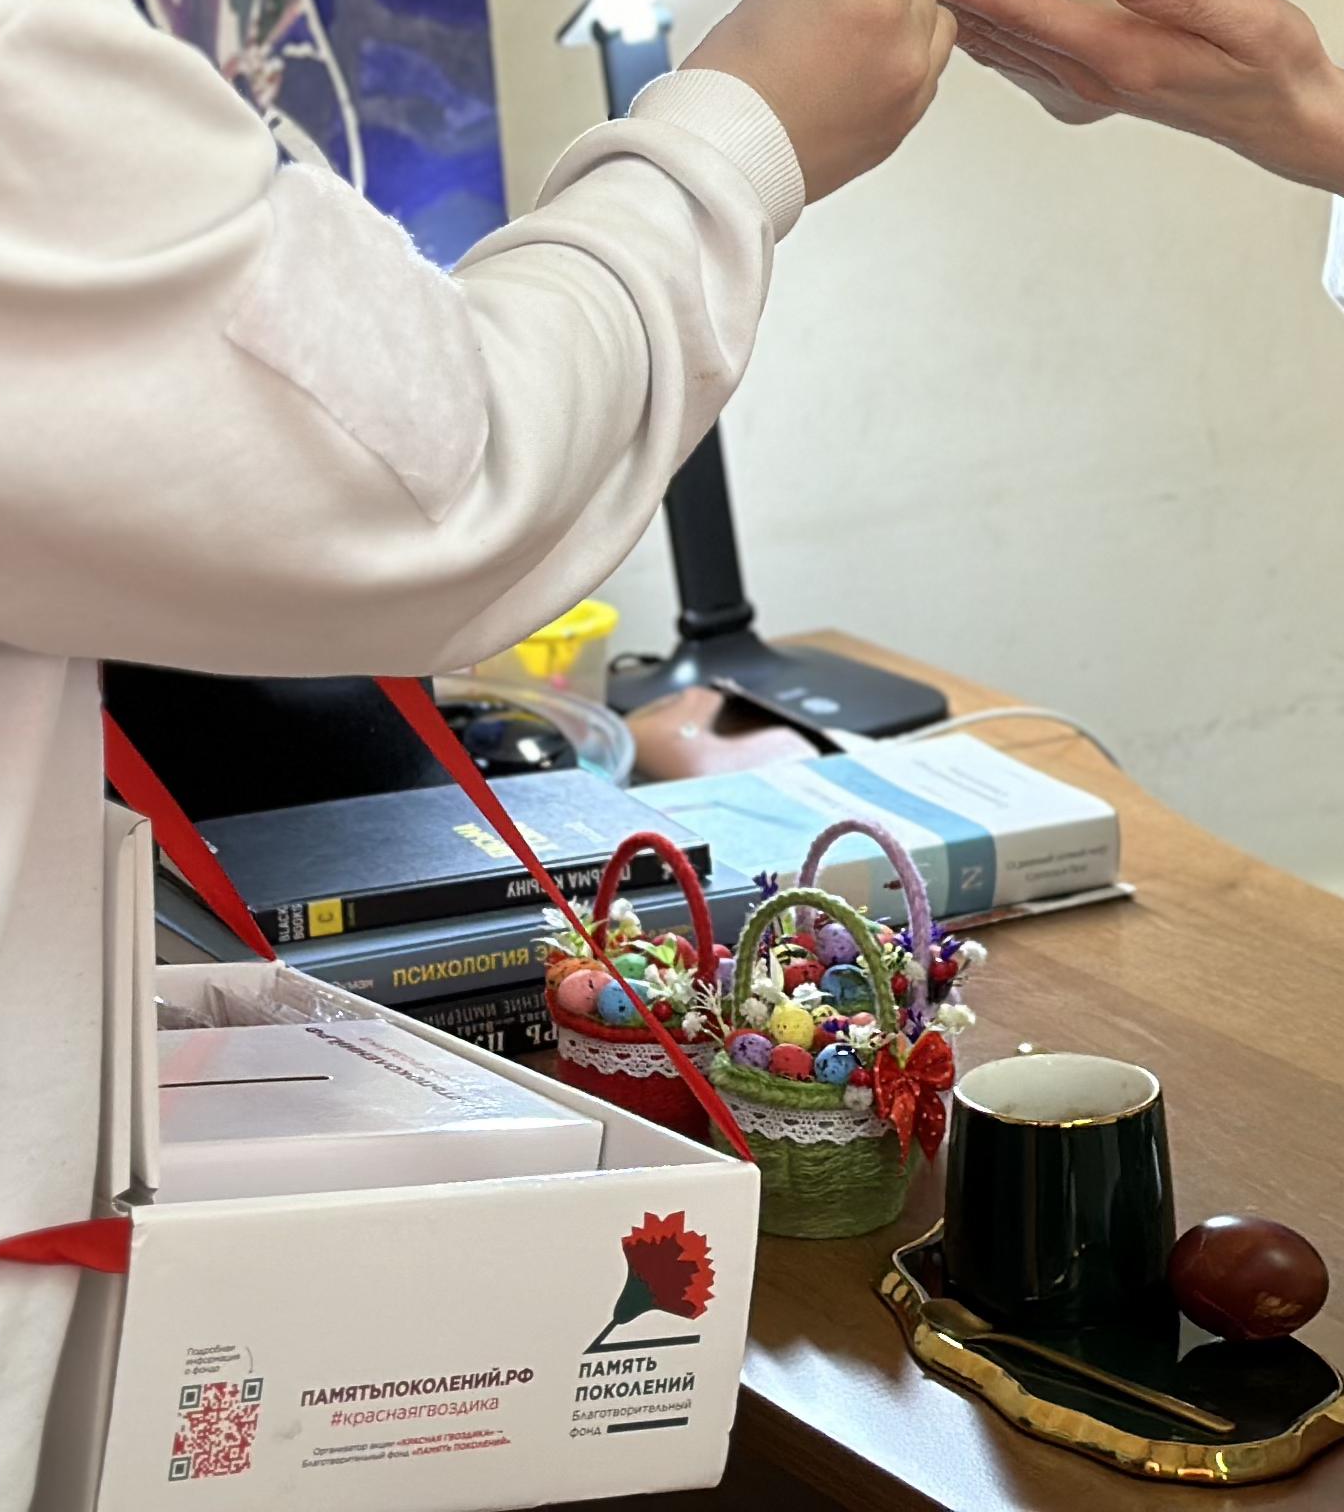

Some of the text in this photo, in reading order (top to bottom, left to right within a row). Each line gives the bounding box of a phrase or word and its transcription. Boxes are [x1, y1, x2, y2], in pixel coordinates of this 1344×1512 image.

[277, 904, 291, 942] BLACK
[290, 901, 305, 941] BOOKS
[392, 946, 531, 988] ПСИХОЛОГИЯ
[577, 1356, 658, 1379] ПАМЯТЬ
[300, 1367, 535, 1408] ПАМЯТЬПОКОЛЕНИЙ.РФ
[574, 1371, 696, 1402] ПОКОЛЕНИЙ
[330, 1396, 500, 1428] #краснаягвоздика
[571, 1398, 693, 1422] Благотворительный
[568, 1426, 602, 1439] фонд
